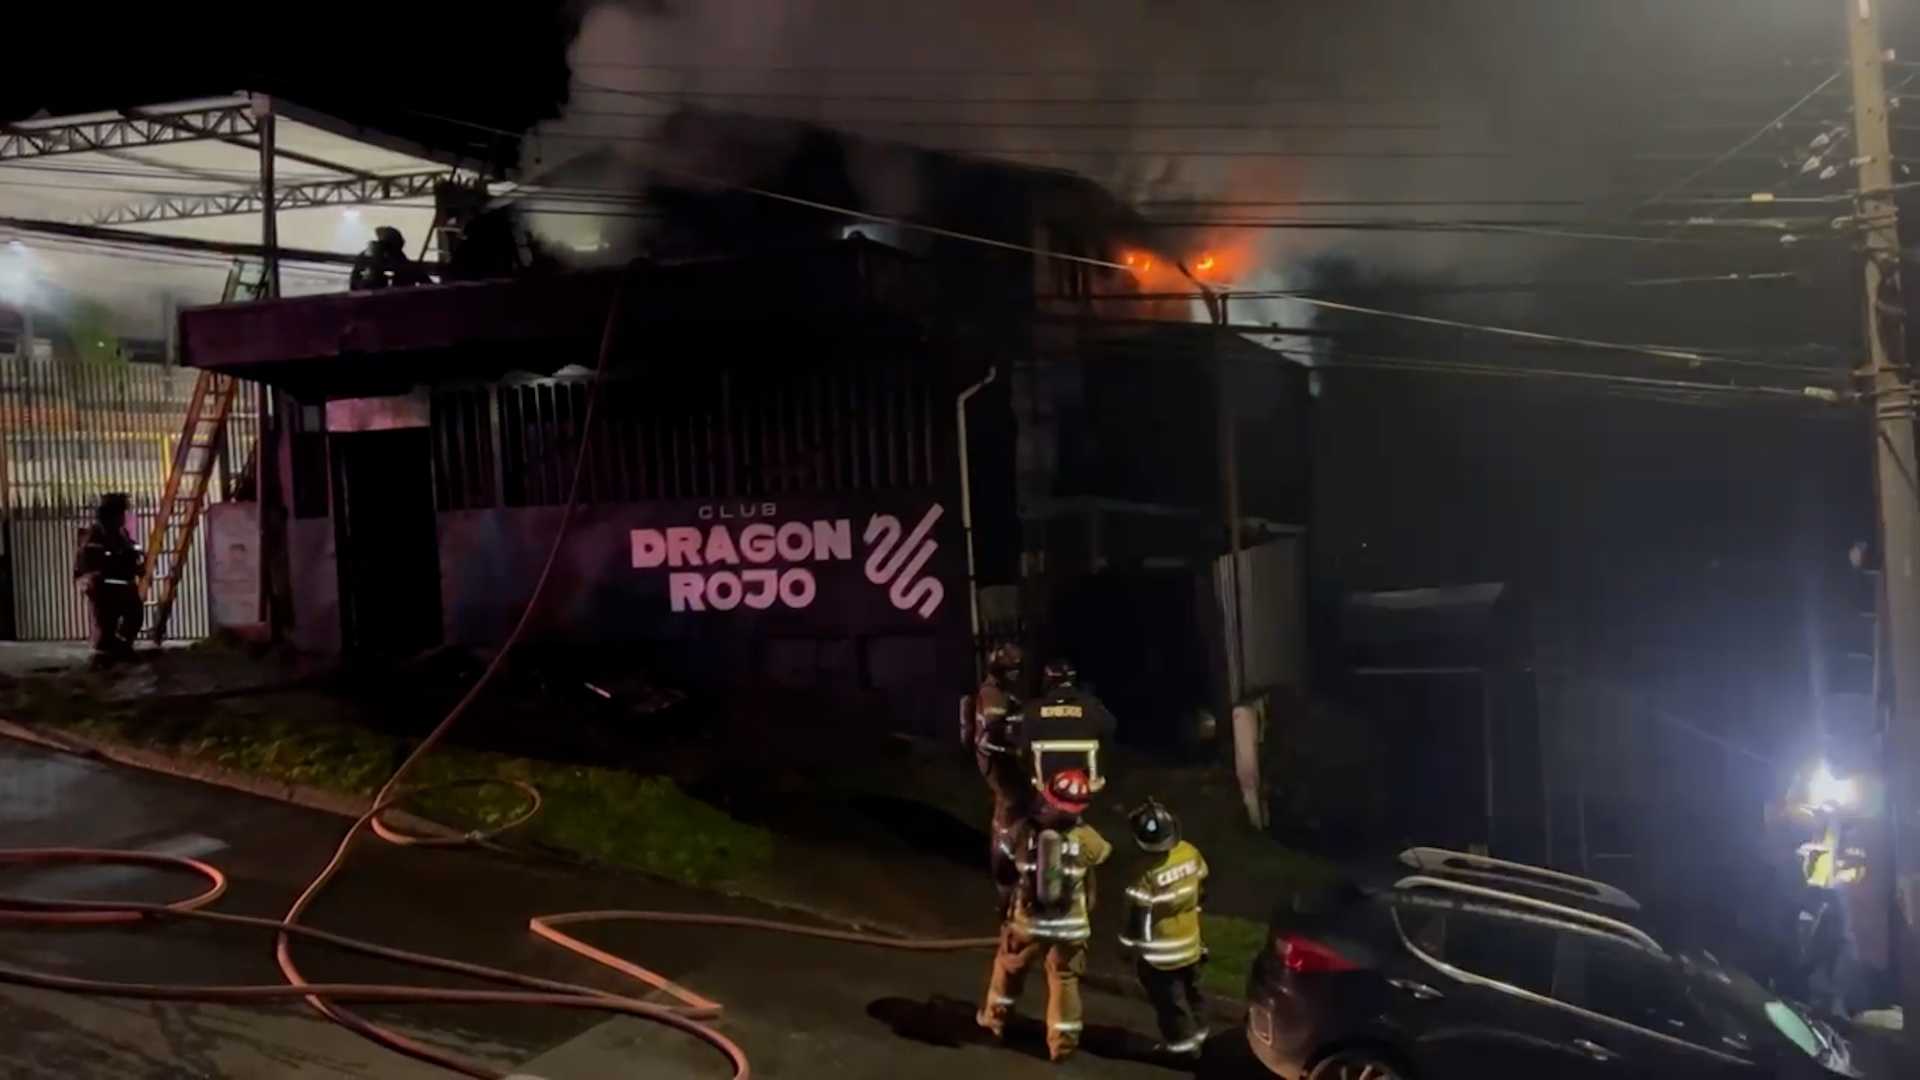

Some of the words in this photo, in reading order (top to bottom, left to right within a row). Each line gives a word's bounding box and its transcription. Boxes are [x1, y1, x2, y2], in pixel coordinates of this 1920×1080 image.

[698, 502, 777, 519] CLUB
[630, 518, 852, 568] DRAGON
[669, 567, 816, 613] ROJO
